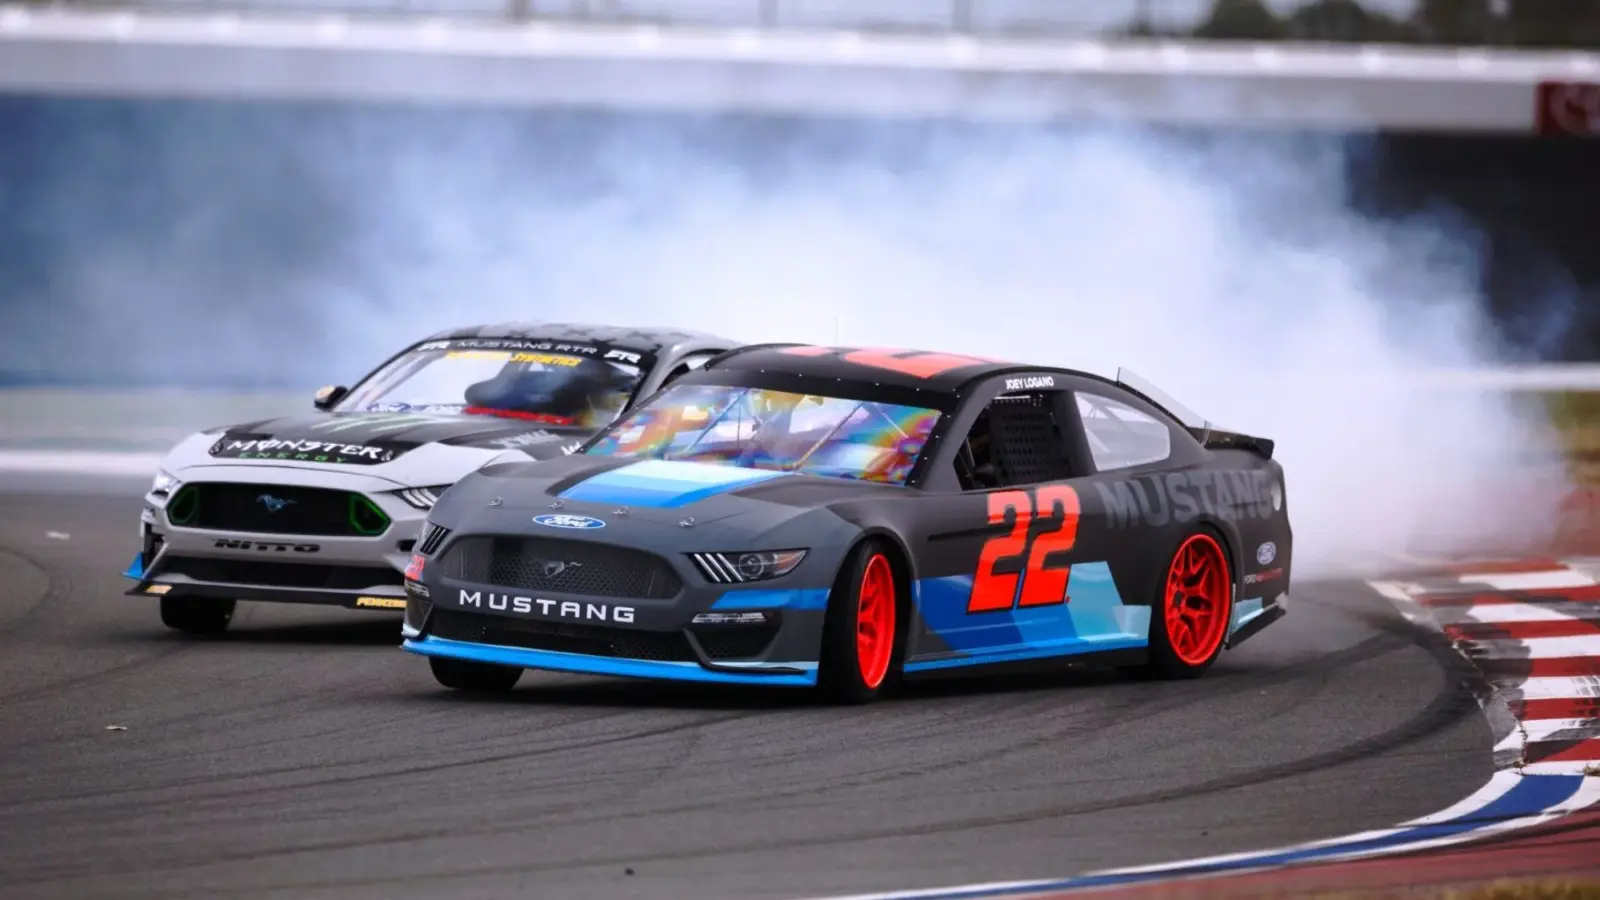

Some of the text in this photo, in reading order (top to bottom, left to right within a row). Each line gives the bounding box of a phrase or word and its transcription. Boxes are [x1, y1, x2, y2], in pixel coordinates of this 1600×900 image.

[458, 340, 598, 354] MUSTANG RTR
[1005, 376, 1055, 390] JOEY LOGANO
[238, 451, 348, 463] ENERGY
[1095, 470, 1272, 529] MUSTANG
[541, 514, 598, 529] Ford
[211, 539, 321, 552] NITTO
[966, 484, 1081, 615] 22
[459, 589, 636, 623] MUSTANG
